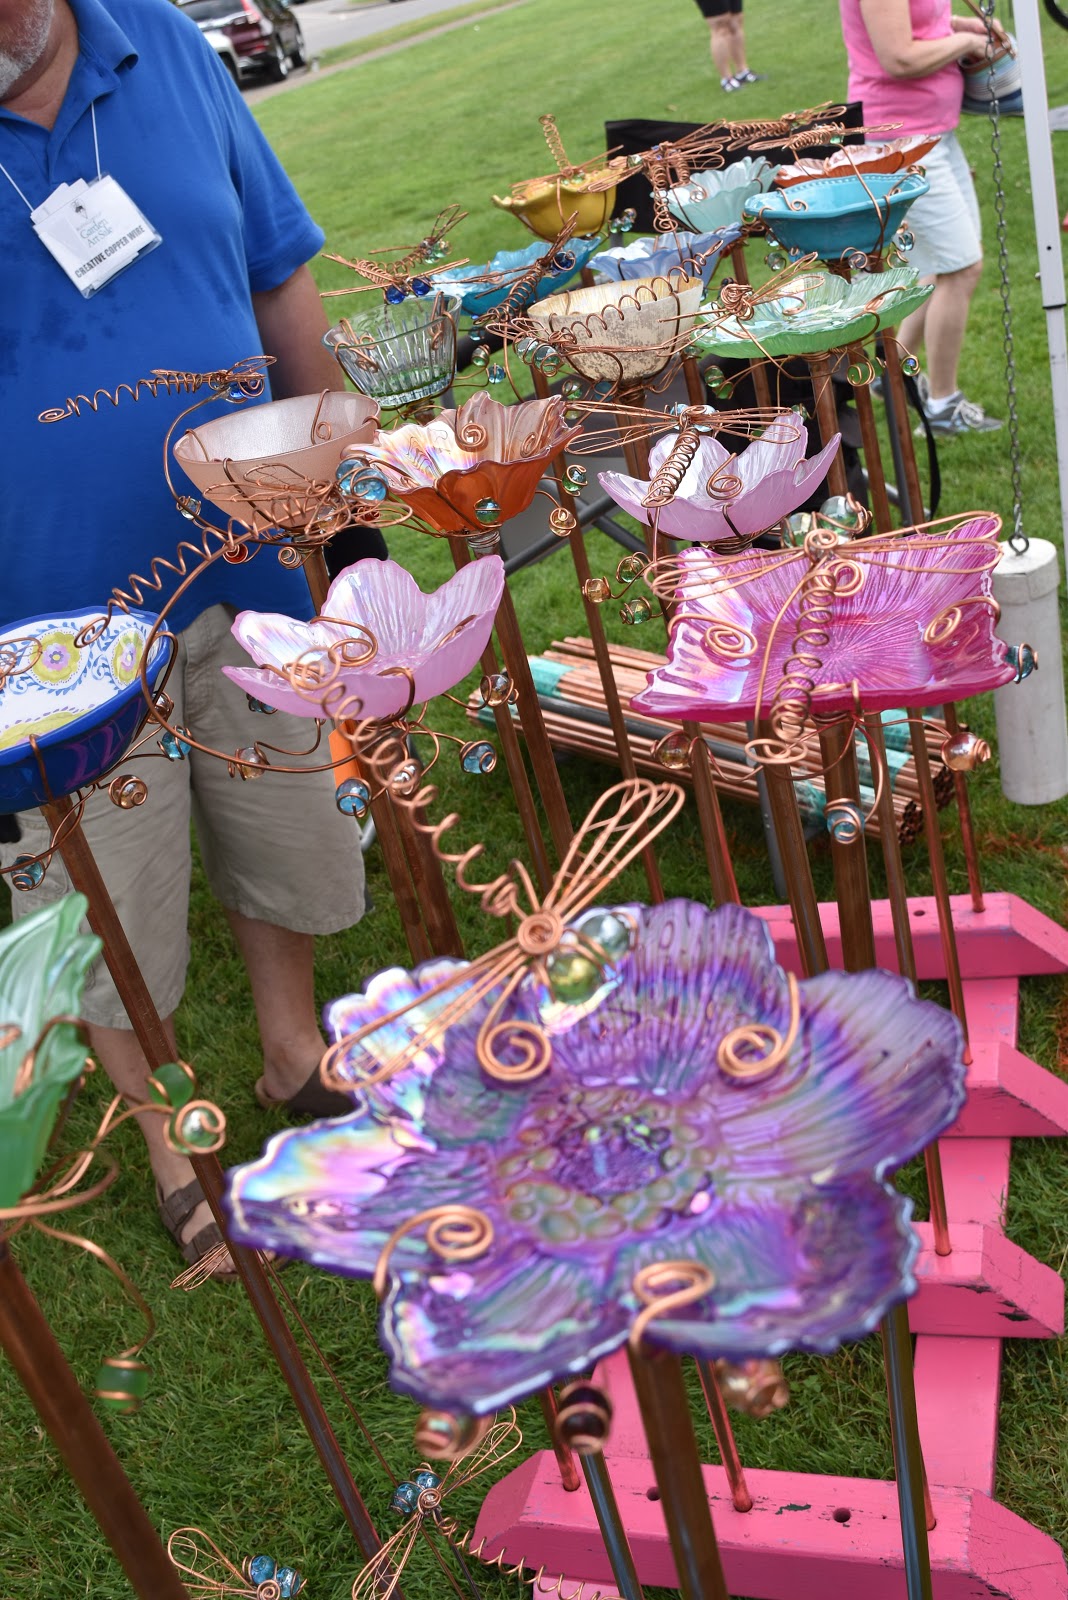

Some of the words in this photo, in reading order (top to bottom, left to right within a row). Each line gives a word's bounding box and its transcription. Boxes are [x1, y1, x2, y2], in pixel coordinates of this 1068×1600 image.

[80, 218, 108, 239] Garden
[87, 233, 100, 247] Art
[74, 252, 106, 278] CREATIVE
[104, 236, 130, 257] COPPER
[127, 225, 145, 241] WIRE
